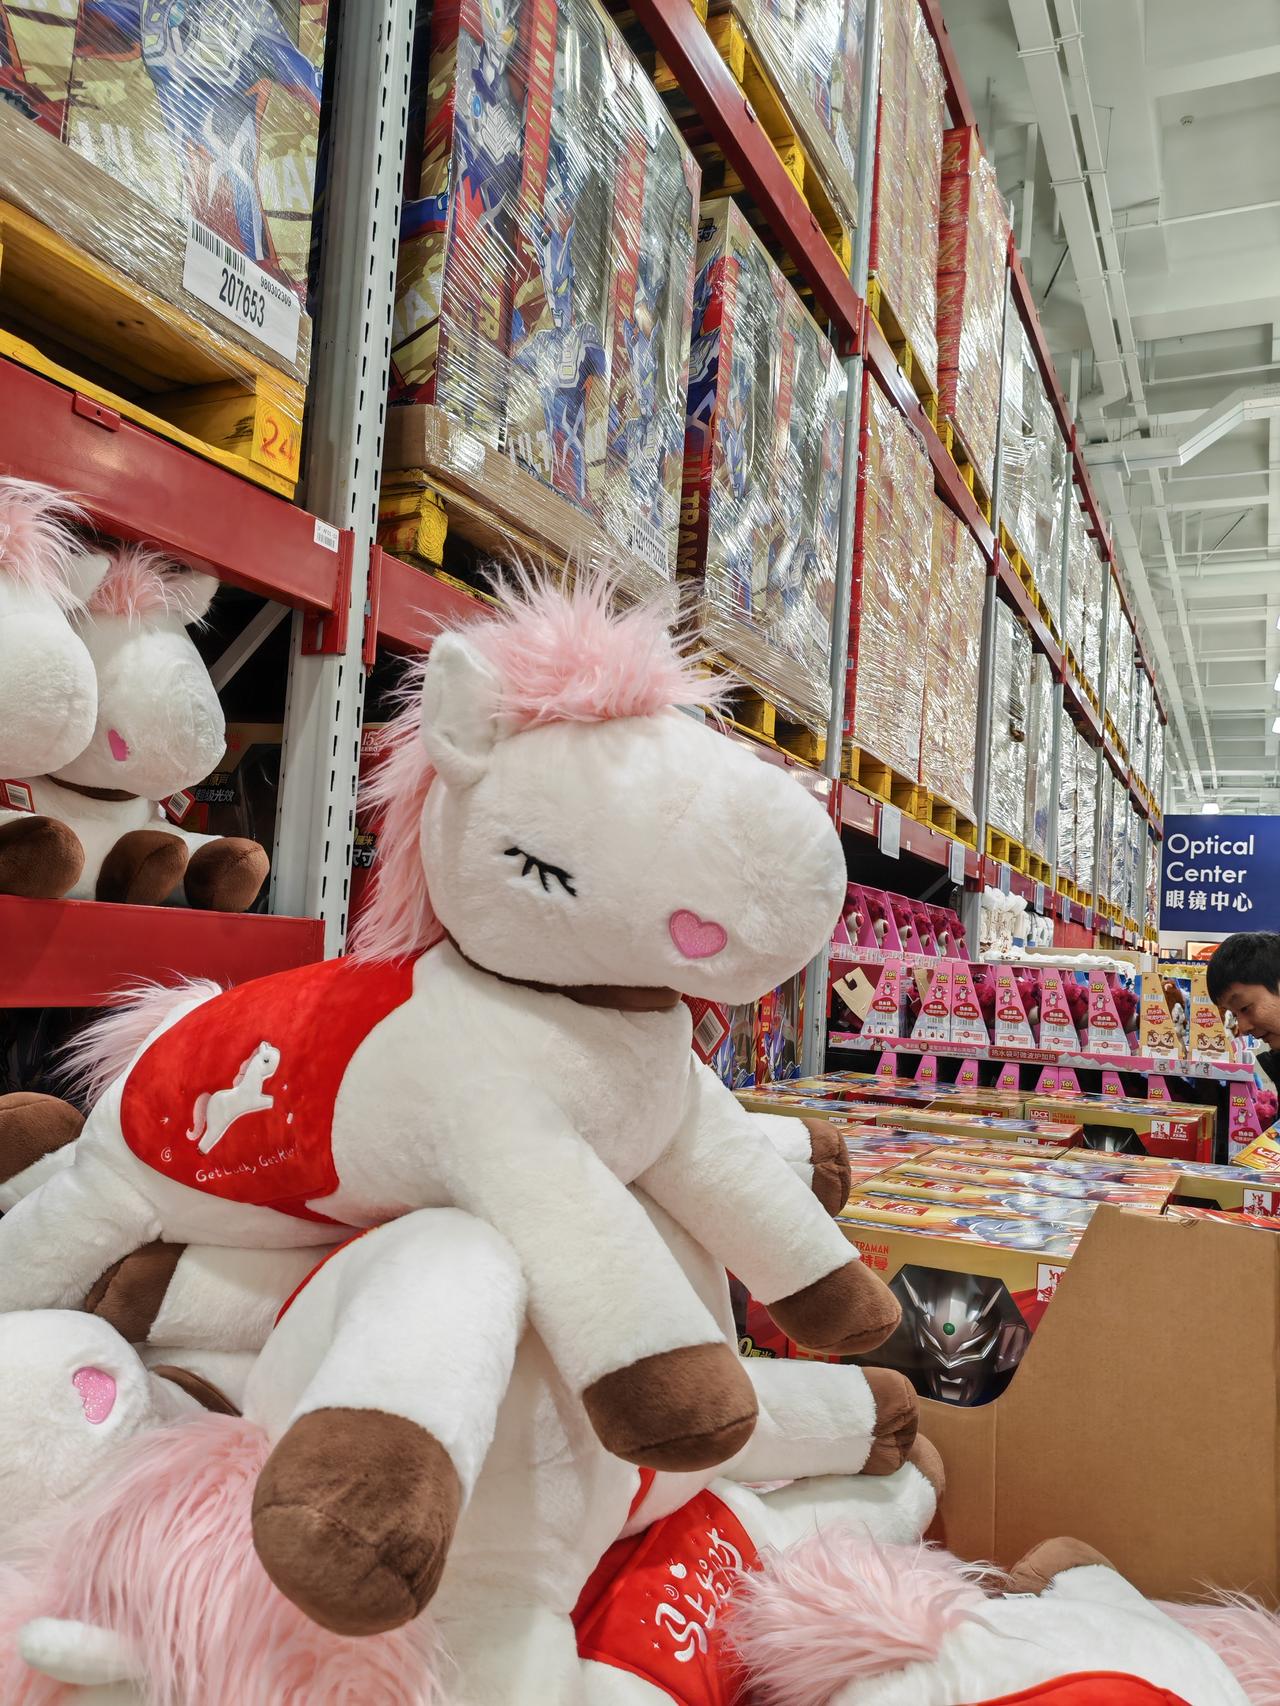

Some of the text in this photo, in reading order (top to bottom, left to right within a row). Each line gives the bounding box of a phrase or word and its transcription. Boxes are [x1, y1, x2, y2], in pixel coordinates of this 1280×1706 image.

[219, 267, 265, 328] 207653
[1167, 833, 1255, 859] Optical
[1166, 861, 1247, 883] Center
[1165, 889, 1253, 913] 眼镜中心
[196, 1166, 222, 1183] Get
